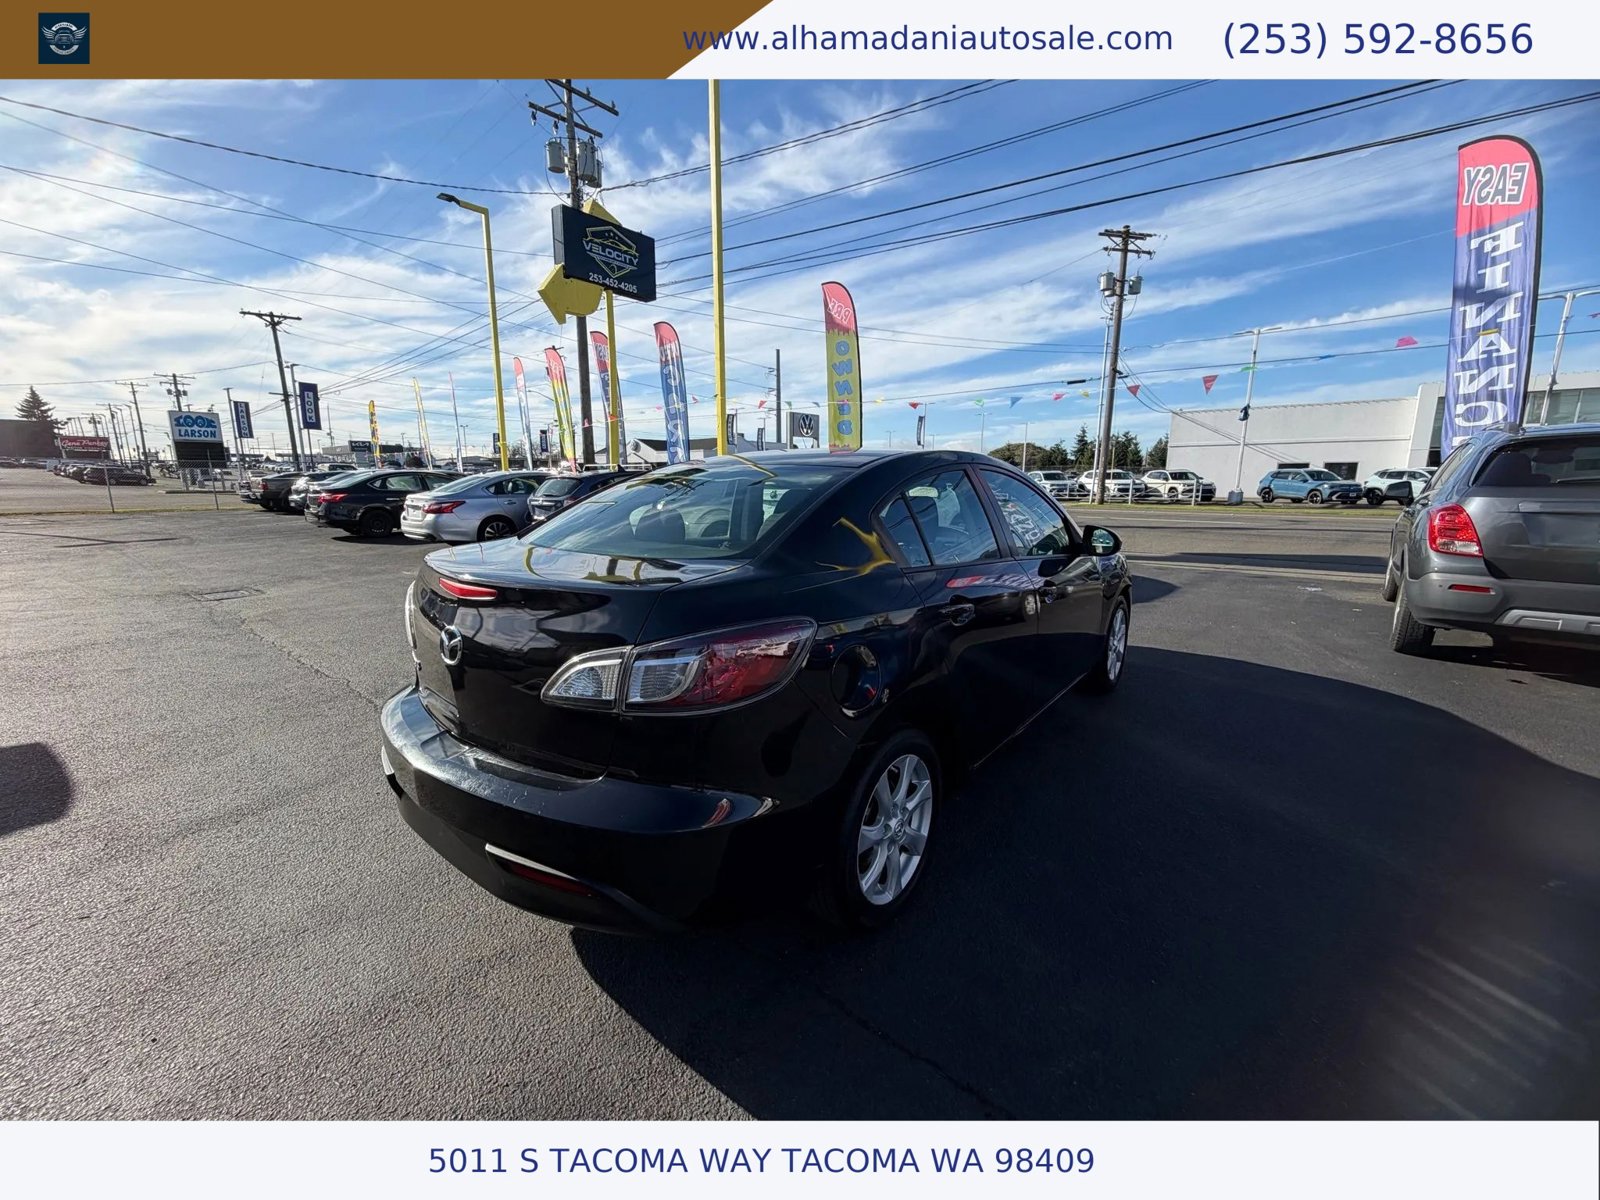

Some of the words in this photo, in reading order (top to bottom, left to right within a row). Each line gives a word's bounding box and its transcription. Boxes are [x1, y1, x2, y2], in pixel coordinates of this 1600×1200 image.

[582, 239, 639, 266] VELOCITY
[588, 272, 638, 294] 253-452-4205
[306, 392, 314, 421] LOOK
[178, 429, 217, 439] LARSON
